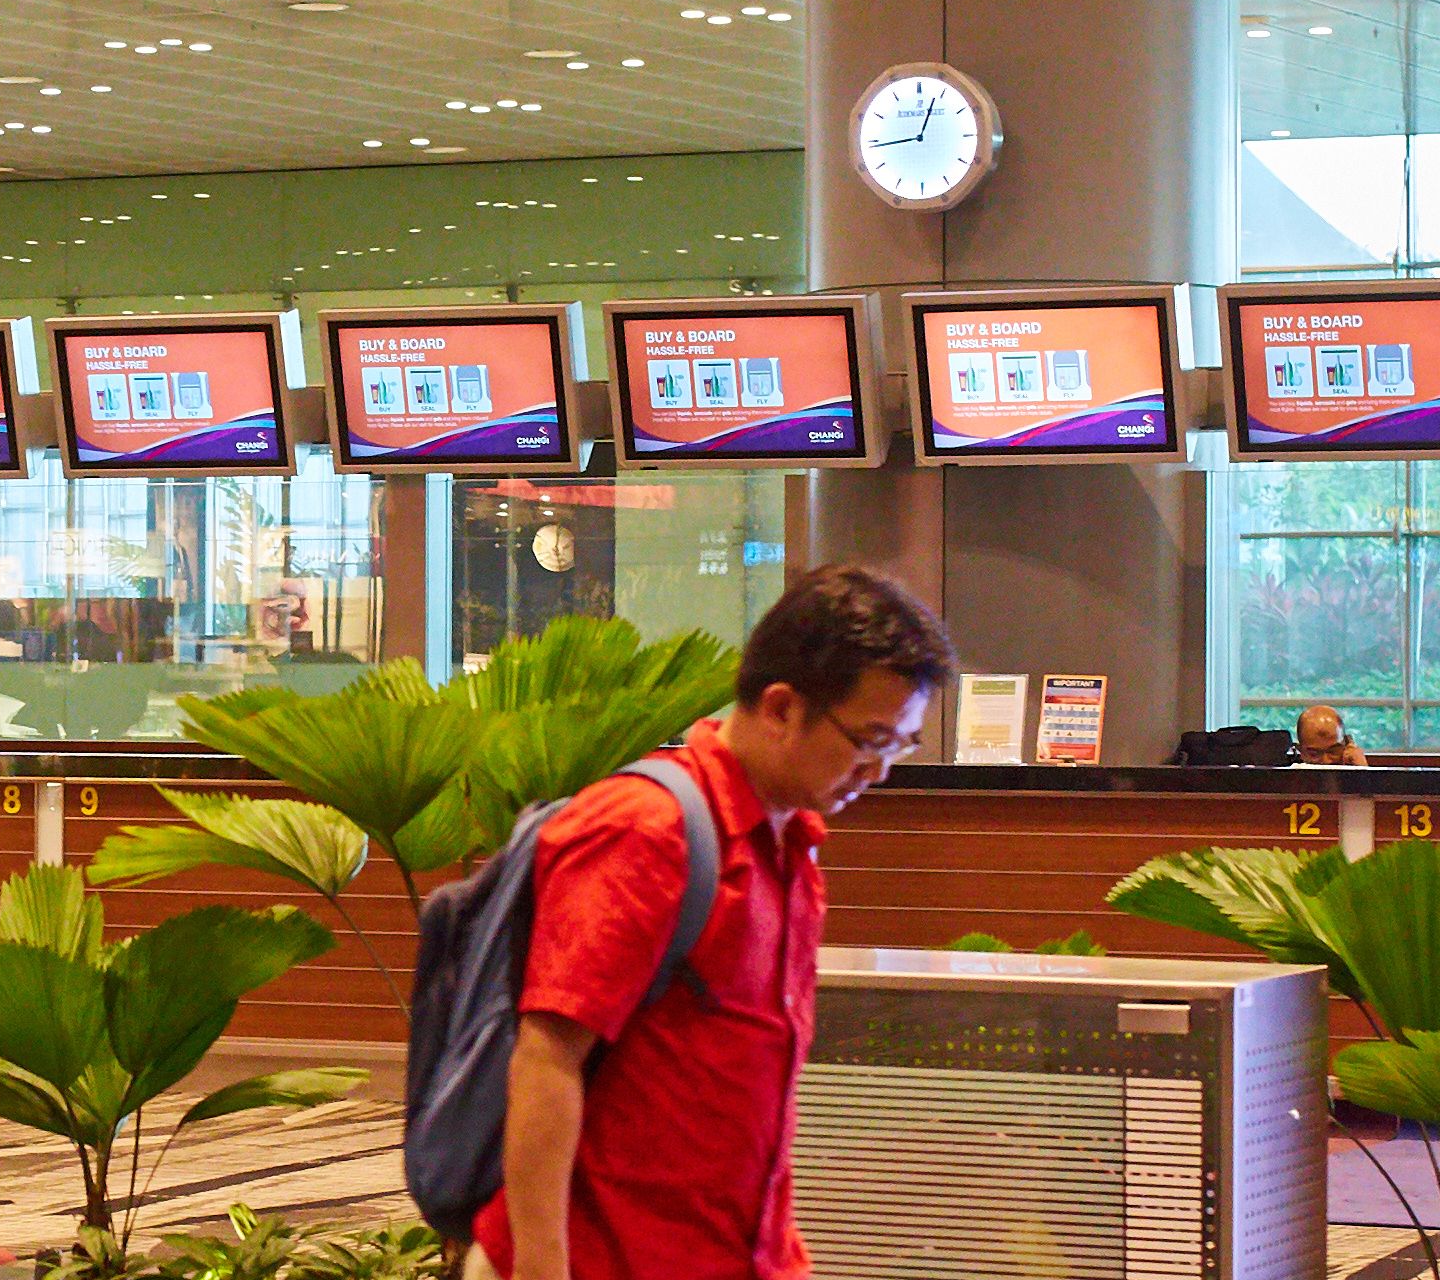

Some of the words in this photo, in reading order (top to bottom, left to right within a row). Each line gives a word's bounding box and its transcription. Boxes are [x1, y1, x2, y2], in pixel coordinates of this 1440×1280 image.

[947, 324, 974, 336] BUY
[979, 324, 988, 335] &
[992, 322, 1041, 335] BOARD
[1264, 317, 1293, 329] BUY
[1297, 317, 1307, 328] &
[1311, 316, 1362, 328] BOARD
[646, 332, 672, 343] BUY
[676, 332, 684, 342] &
[689, 330, 735, 342] BOARD
[1264, 332, 1339, 342] HASSLE-FREE
[359, 340, 385, 351] BUY
[389, 339, 398, 350] &
[401, 338, 445, 350] BOARD
[947, 339, 1019, 348] HASSLE-FREE
[85, 348, 109, 358] BUY
[113, 347, 121, 357] &
[124, 346, 167, 357] BOARD
[647, 346, 714, 355] HASSLE-FREE
[361, 353, 425, 363] HASSLE-FREE
[86, 361, 148, 370] HASSLE-FREE
[1053, 680, 1096, 688] IMPORTANT
[3, 786, 21, 814] 8
[81, 787, 99, 815] 9
[1284, 803, 1321, 836] 12
[1395, 804, 1432, 837] 13
